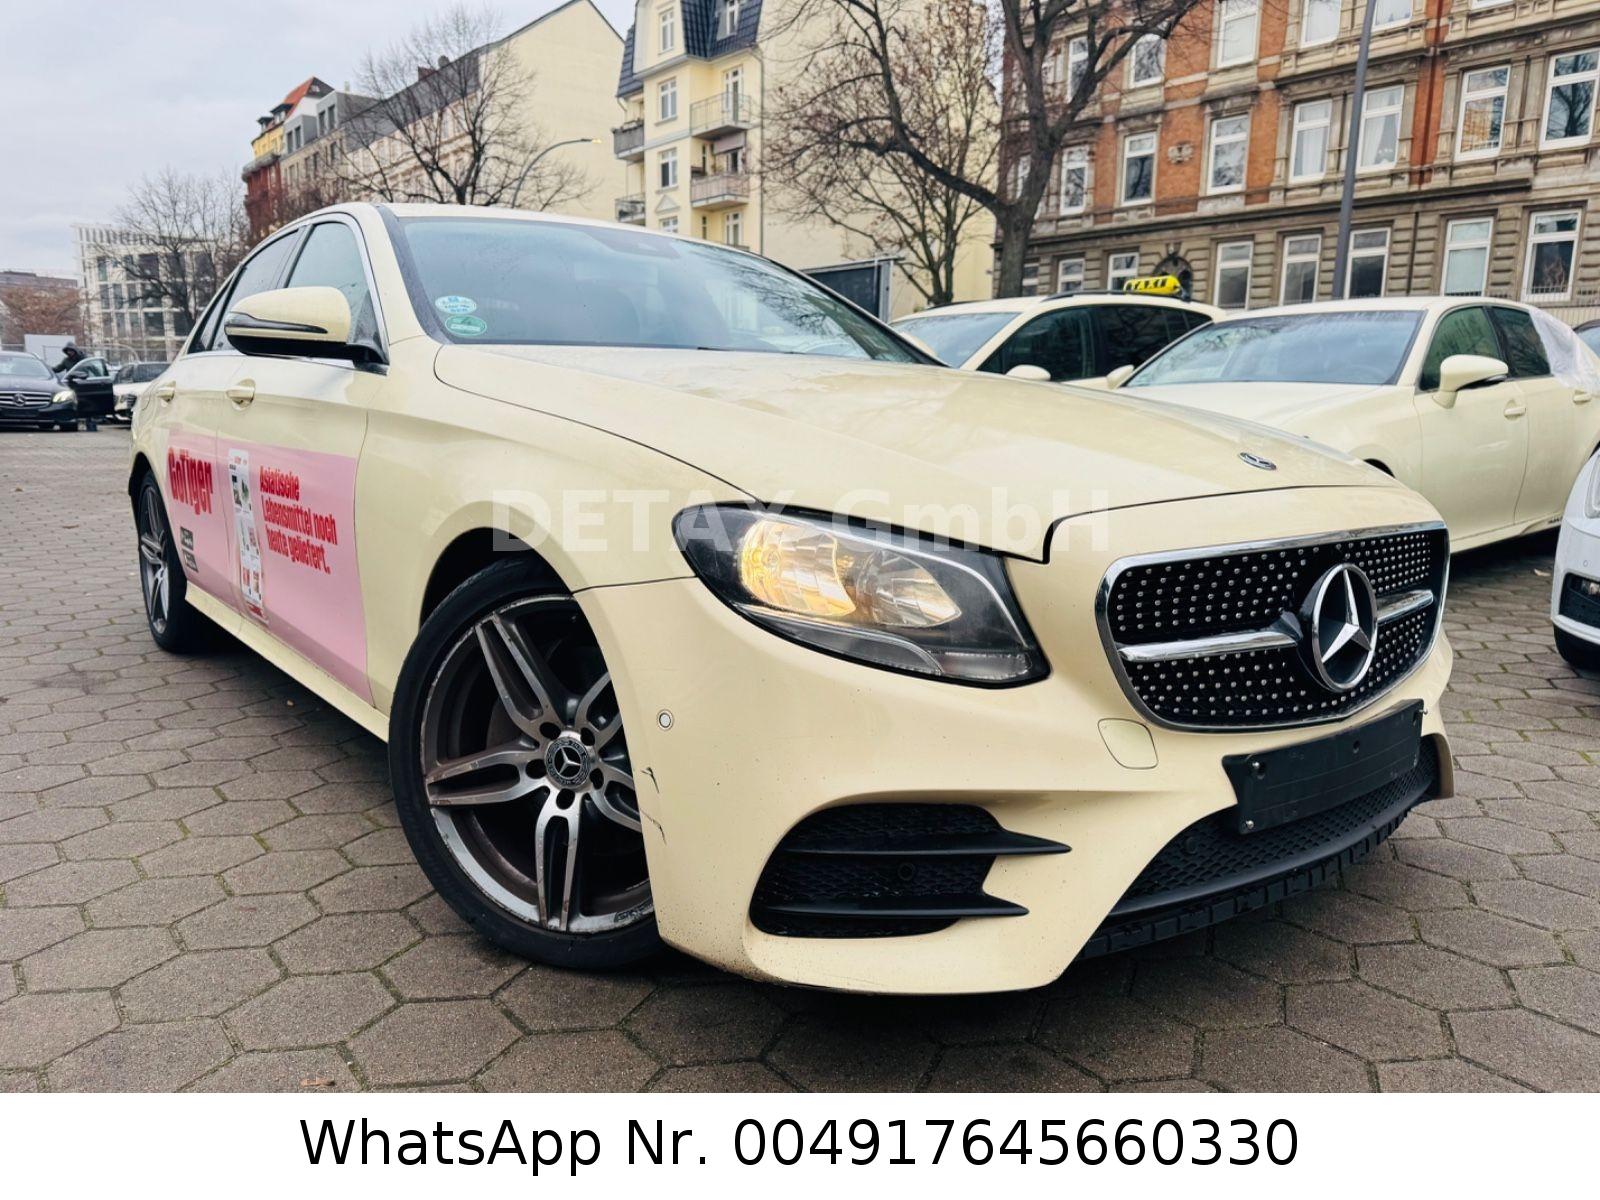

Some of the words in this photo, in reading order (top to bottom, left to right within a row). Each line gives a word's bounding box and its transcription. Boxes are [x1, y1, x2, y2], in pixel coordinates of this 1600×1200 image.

[259, 466, 299, 501] Asiatische
[261, 494, 313, 537] Lebensmittel
[313, 512, 337, 545] noch
[265, 524, 289, 557] heute
[287, 535, 331, 574] geliefert.
